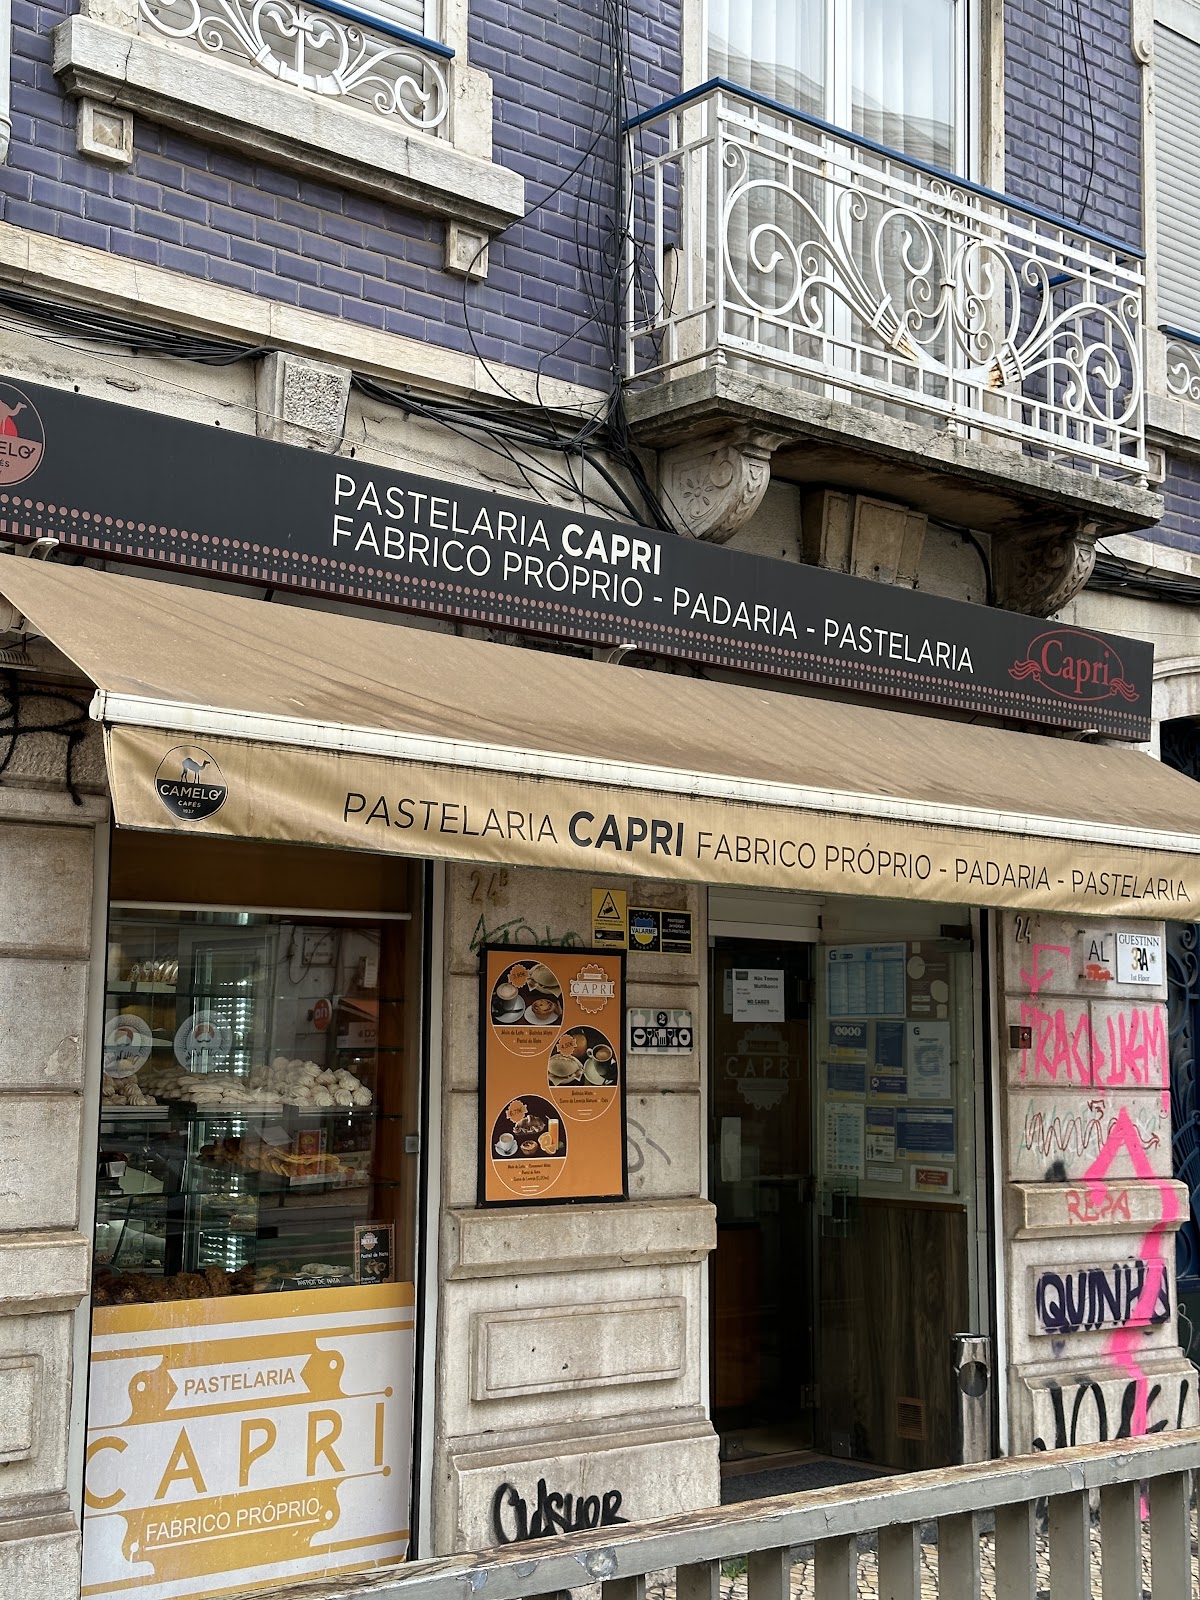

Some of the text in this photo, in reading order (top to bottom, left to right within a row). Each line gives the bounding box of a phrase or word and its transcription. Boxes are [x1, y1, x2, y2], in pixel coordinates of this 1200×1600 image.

[335, 473, 662, 575] PASTELARIA CAPRI
[332, 514, 492, 578] FABRICO
[503, 550, 644, 608] PRÓPRIO
[673, 587, 797, 640] PADARIA
[824, 618, 975, 674] PASTELARIA
[1042, 639, 1110, 694] Capri
[160, 784, 222, 801] CAMELO
[178, 800, 201, 808] CAFÉS
[344, 791, 557, 844] PASTELARIA
[568, 810, 684, 857] CAPRI
[697, 831, 815, 870] FABRICO
[825, 842, 931, 881] PRÓPRIO
[955, 858, 1051, 891] PADARIA
[1071, 864, 1191, 903] PASTELARIA
[631, 926, 657, 936] VALARME
[1118, 934, 1160, 947] GUESTINN
[1088, 940, 1109, 962] AL
[572, 983, 613, 995] CAPRI
[1139, 974, 1150, 982] Floor
[726, 1056, 800, 1078] CAPRI
[184, 1367, 296, 1396] PASTELARIA
[86, 1402, 385, 1509] CAPRI
[146, 1497, 320, 1542] FABRICO PRÓPRIO
